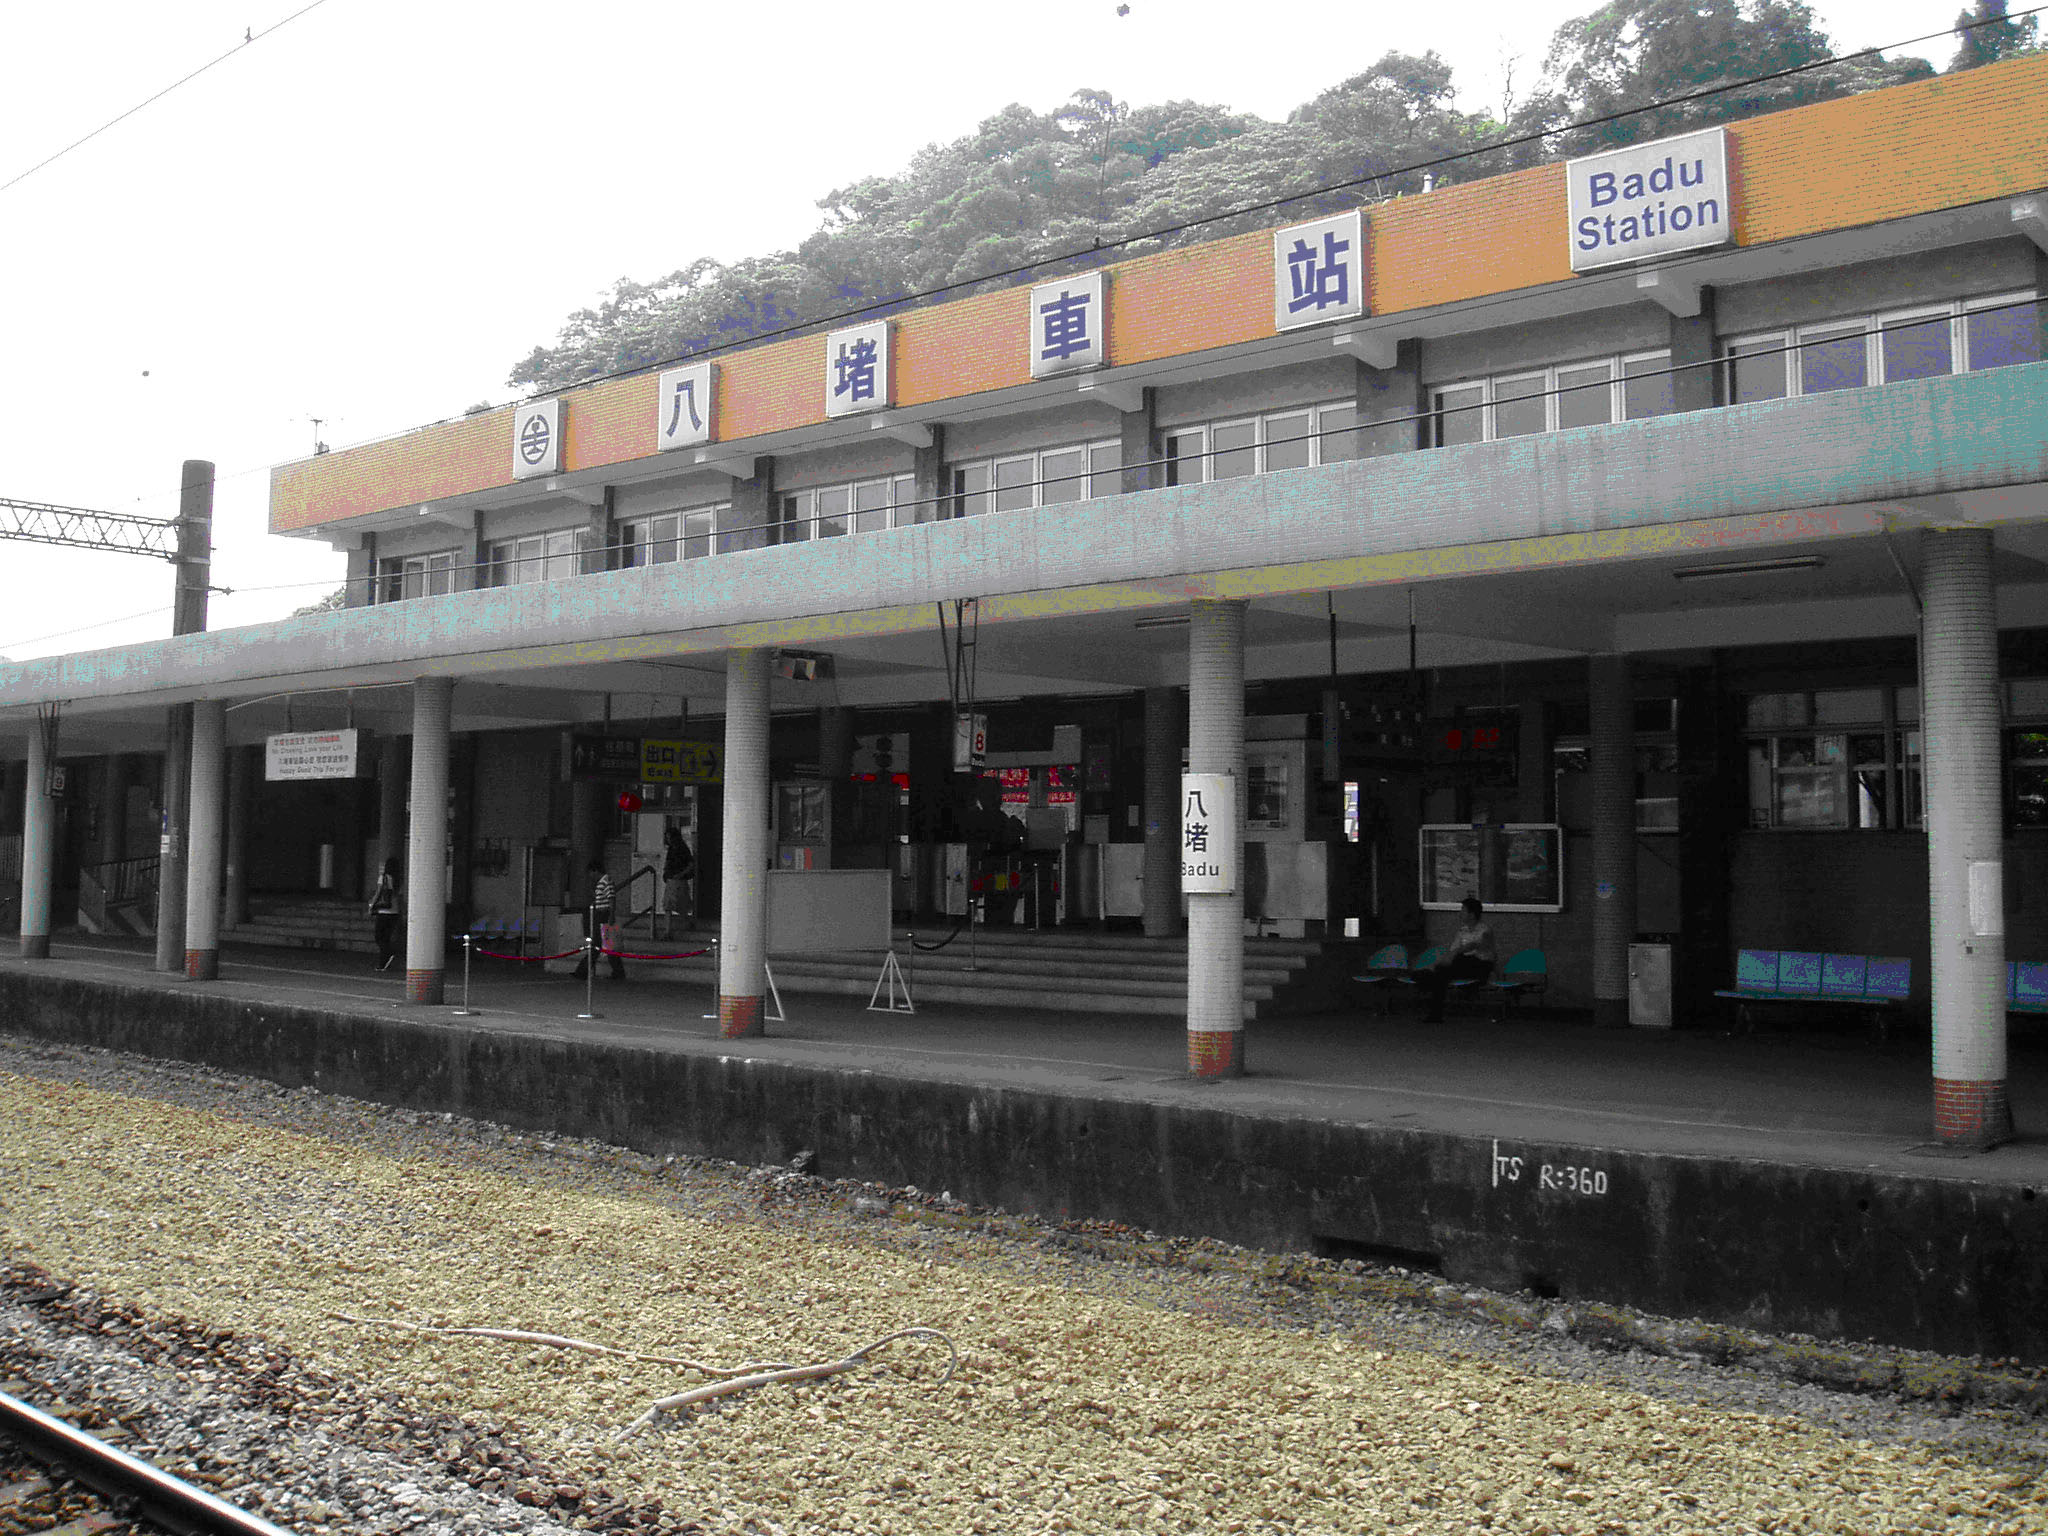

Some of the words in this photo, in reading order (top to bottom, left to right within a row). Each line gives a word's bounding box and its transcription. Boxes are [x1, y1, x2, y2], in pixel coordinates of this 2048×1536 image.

[1590, 157, 1703, 208] Badu
[1578, 198, 1719, 251] Station
[1185, 790, 1208, 853] 八堵
